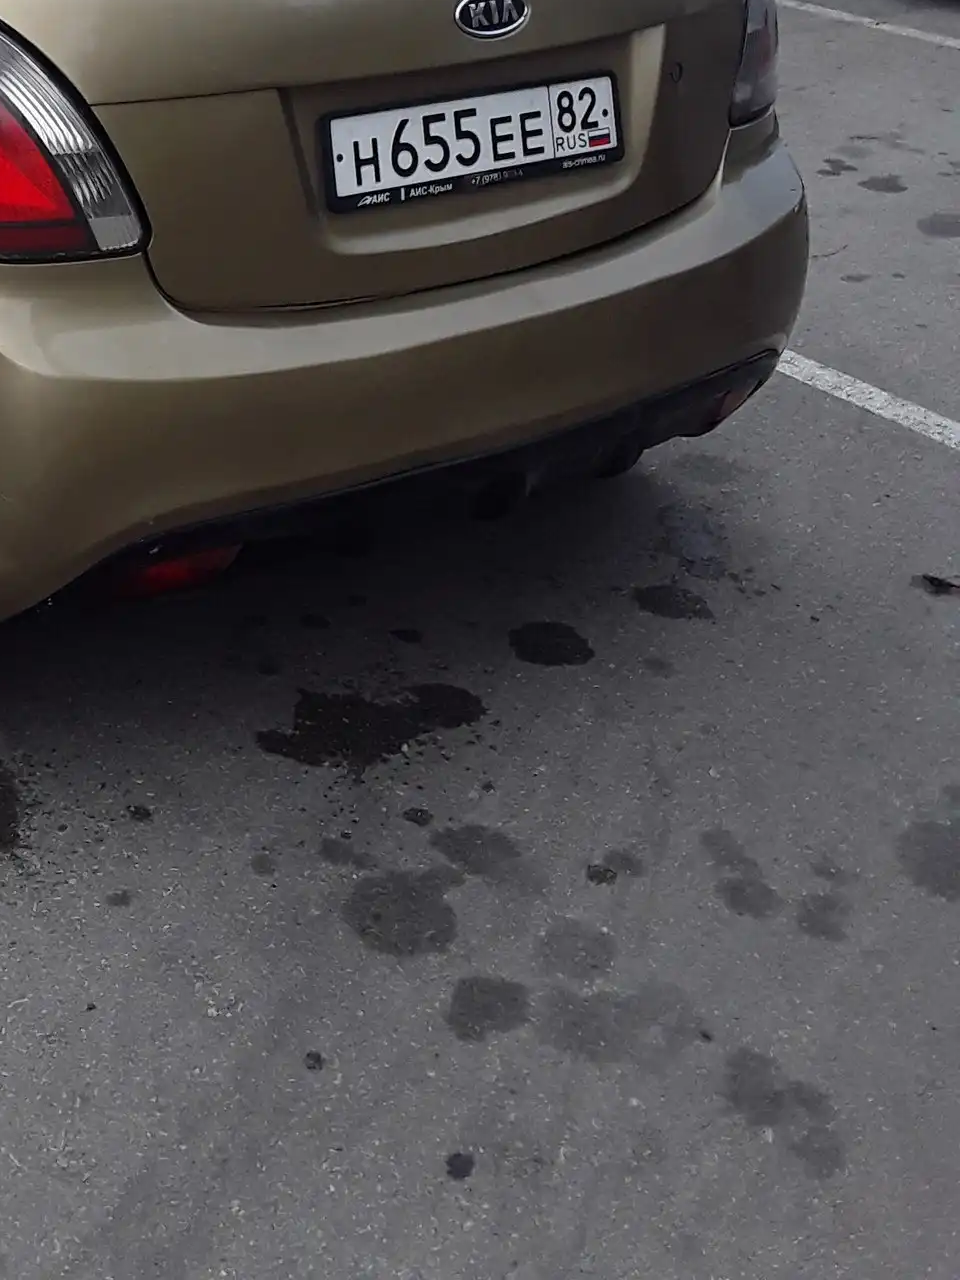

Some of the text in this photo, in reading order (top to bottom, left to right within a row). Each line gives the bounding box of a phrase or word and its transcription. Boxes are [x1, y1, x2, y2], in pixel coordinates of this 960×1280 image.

[556, 86, 599, 132] 82
[556, 133, 588, 152] RUS
[409, 183, 453, 198] АИС-Крым
